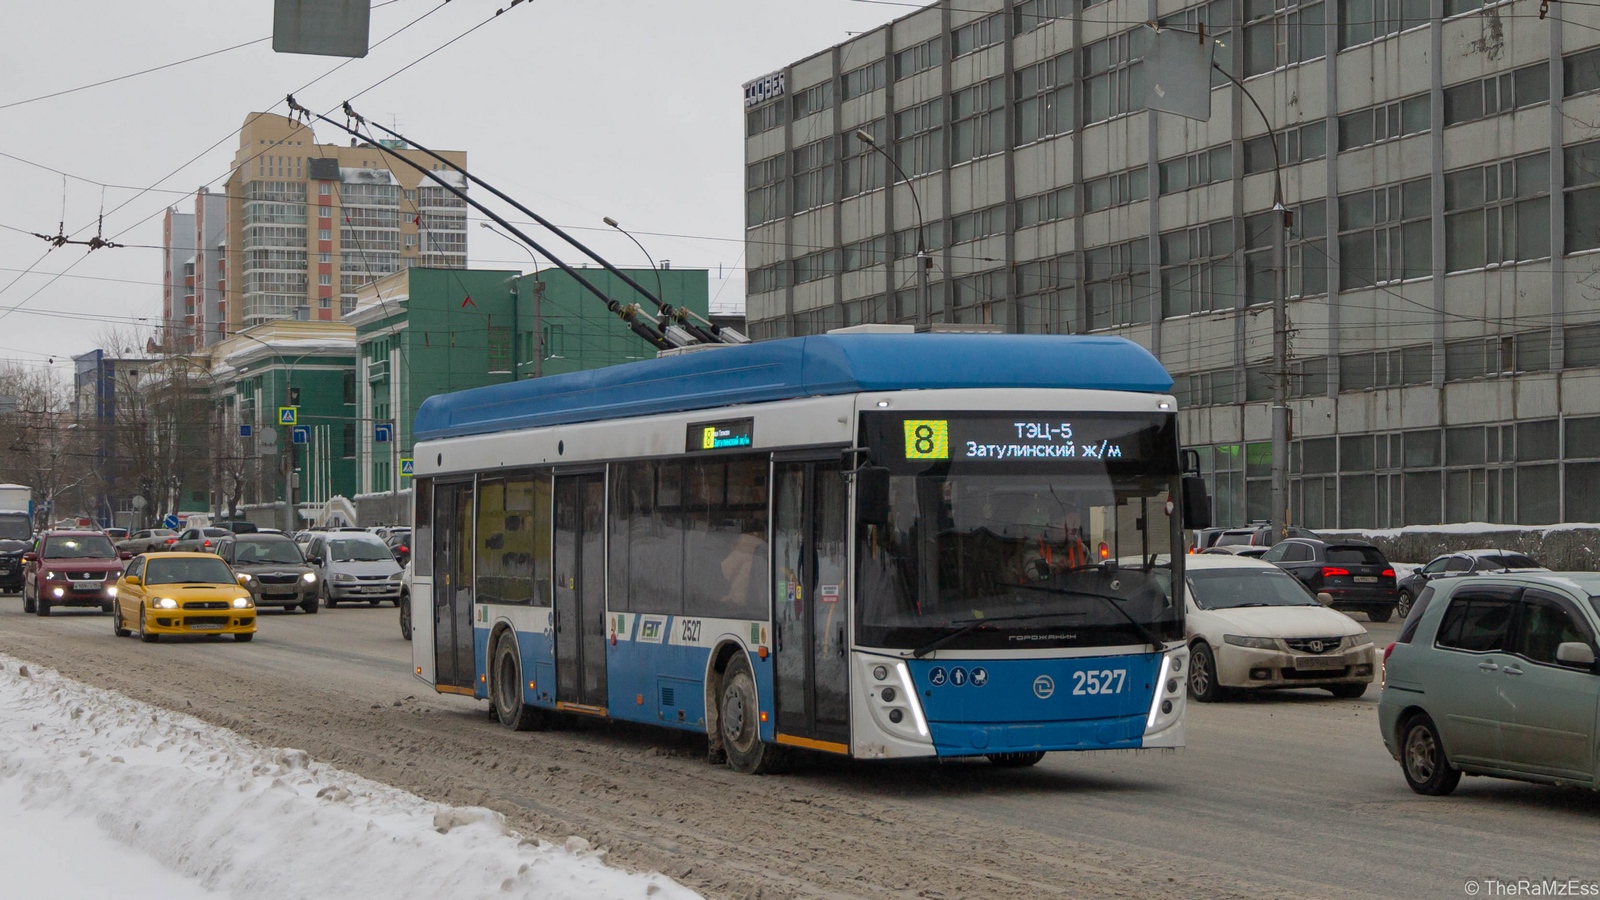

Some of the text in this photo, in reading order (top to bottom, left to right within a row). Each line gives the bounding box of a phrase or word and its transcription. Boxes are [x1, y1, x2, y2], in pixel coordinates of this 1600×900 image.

[915, 425, 934, 453] 8
[1014, 423, 1073, 440] ТЭЦ-5
[966, 440, 1121, 459] Затулинский ж/м
[682, 619, 701, 642] 2527
[1072, 669, 1127, 695] 2527
